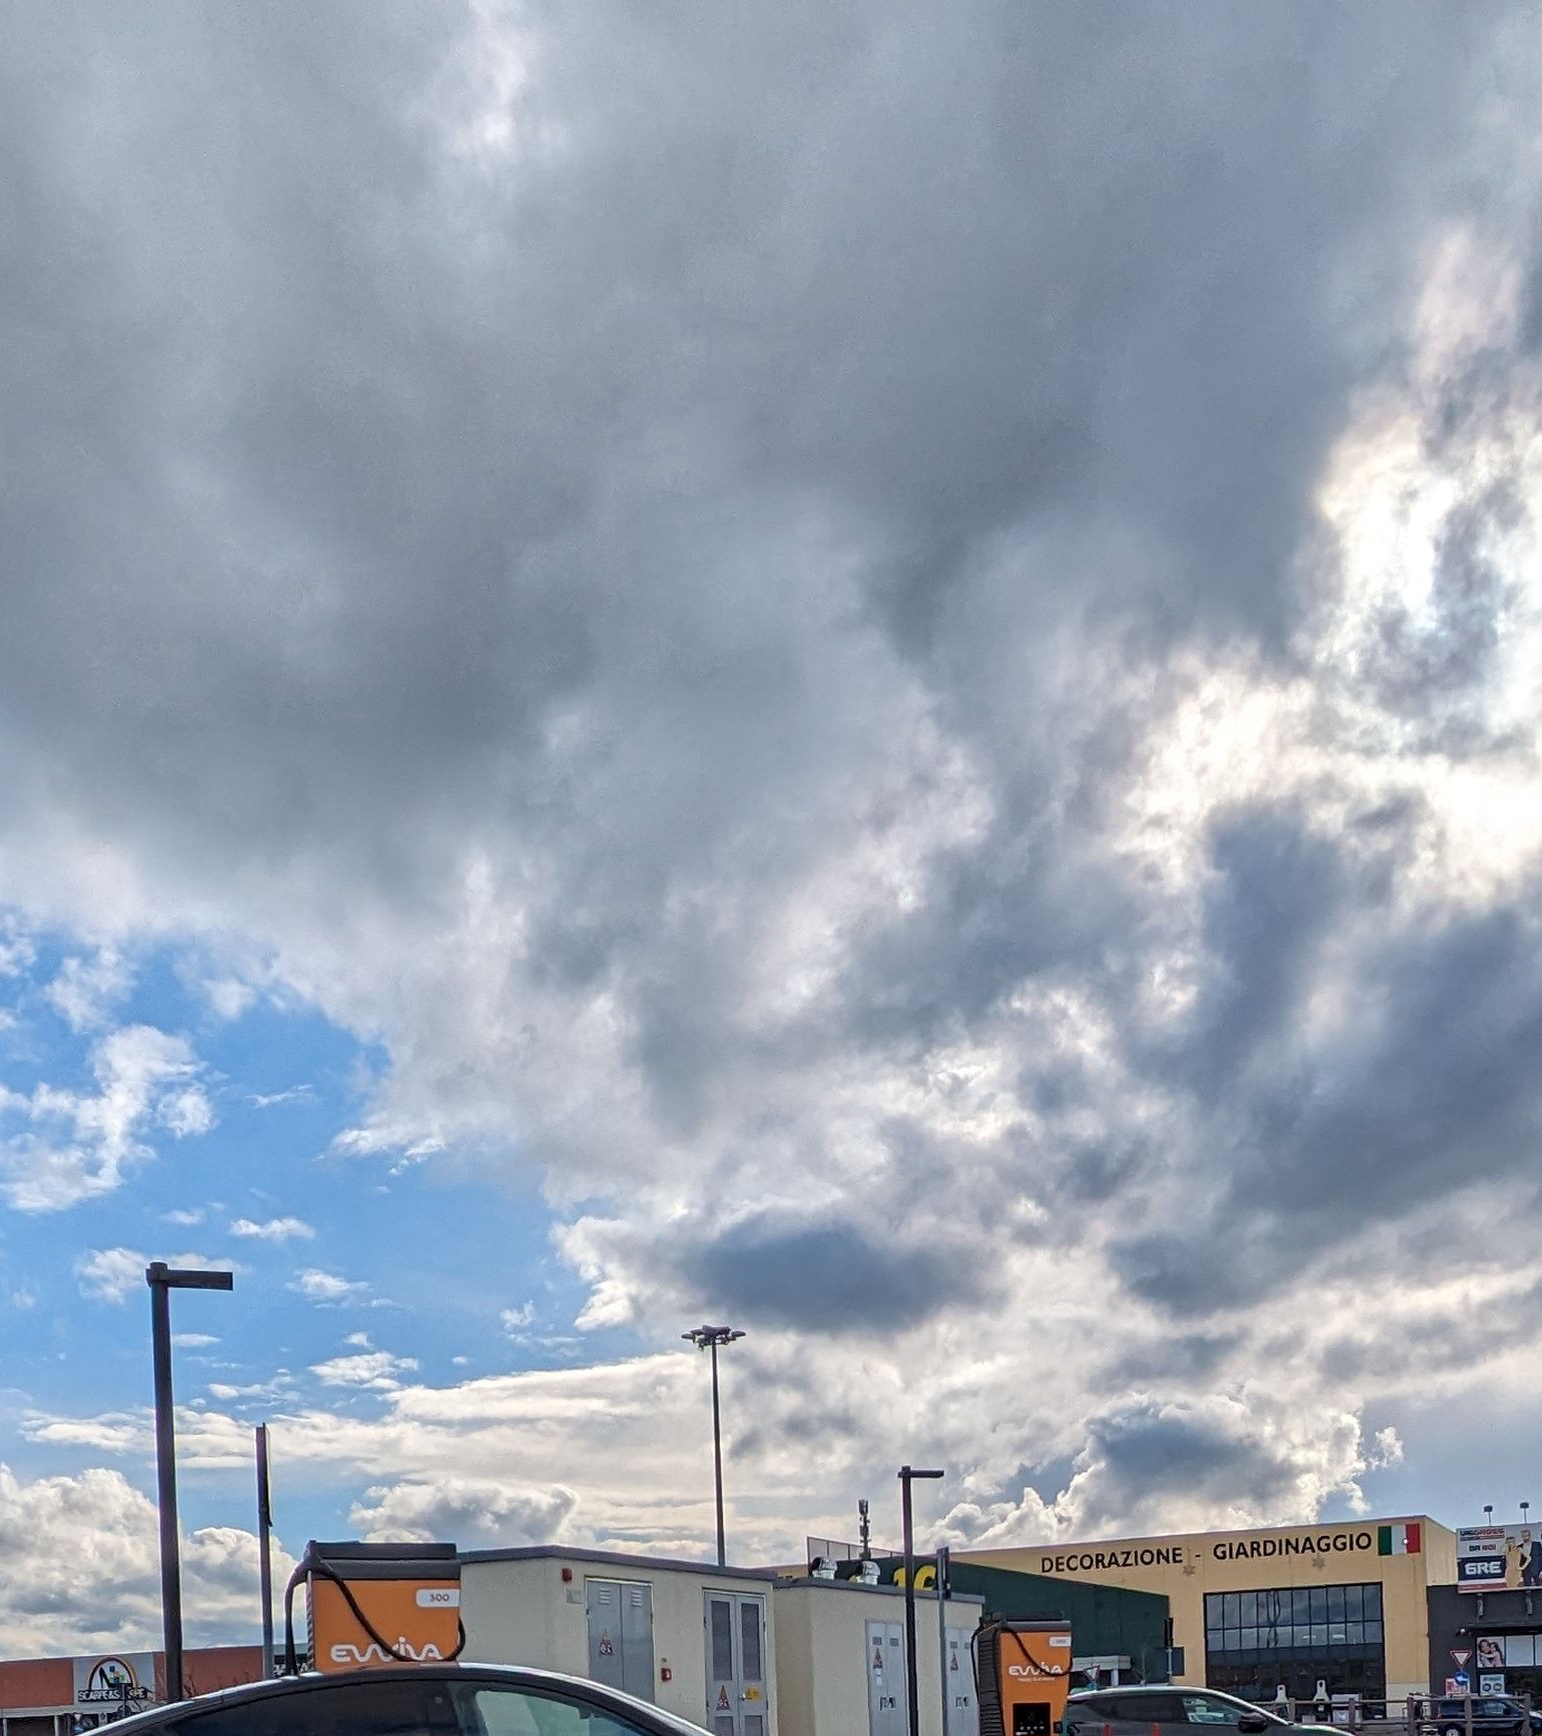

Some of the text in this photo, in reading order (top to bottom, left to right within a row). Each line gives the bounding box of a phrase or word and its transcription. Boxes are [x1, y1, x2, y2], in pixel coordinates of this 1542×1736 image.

[1041, 1547, 1184, 1573] DECORAZIONE
[1213, 1532, 1372, 1560] GIARDINAGGIO
[429, 1593, 450, 1602] 300
